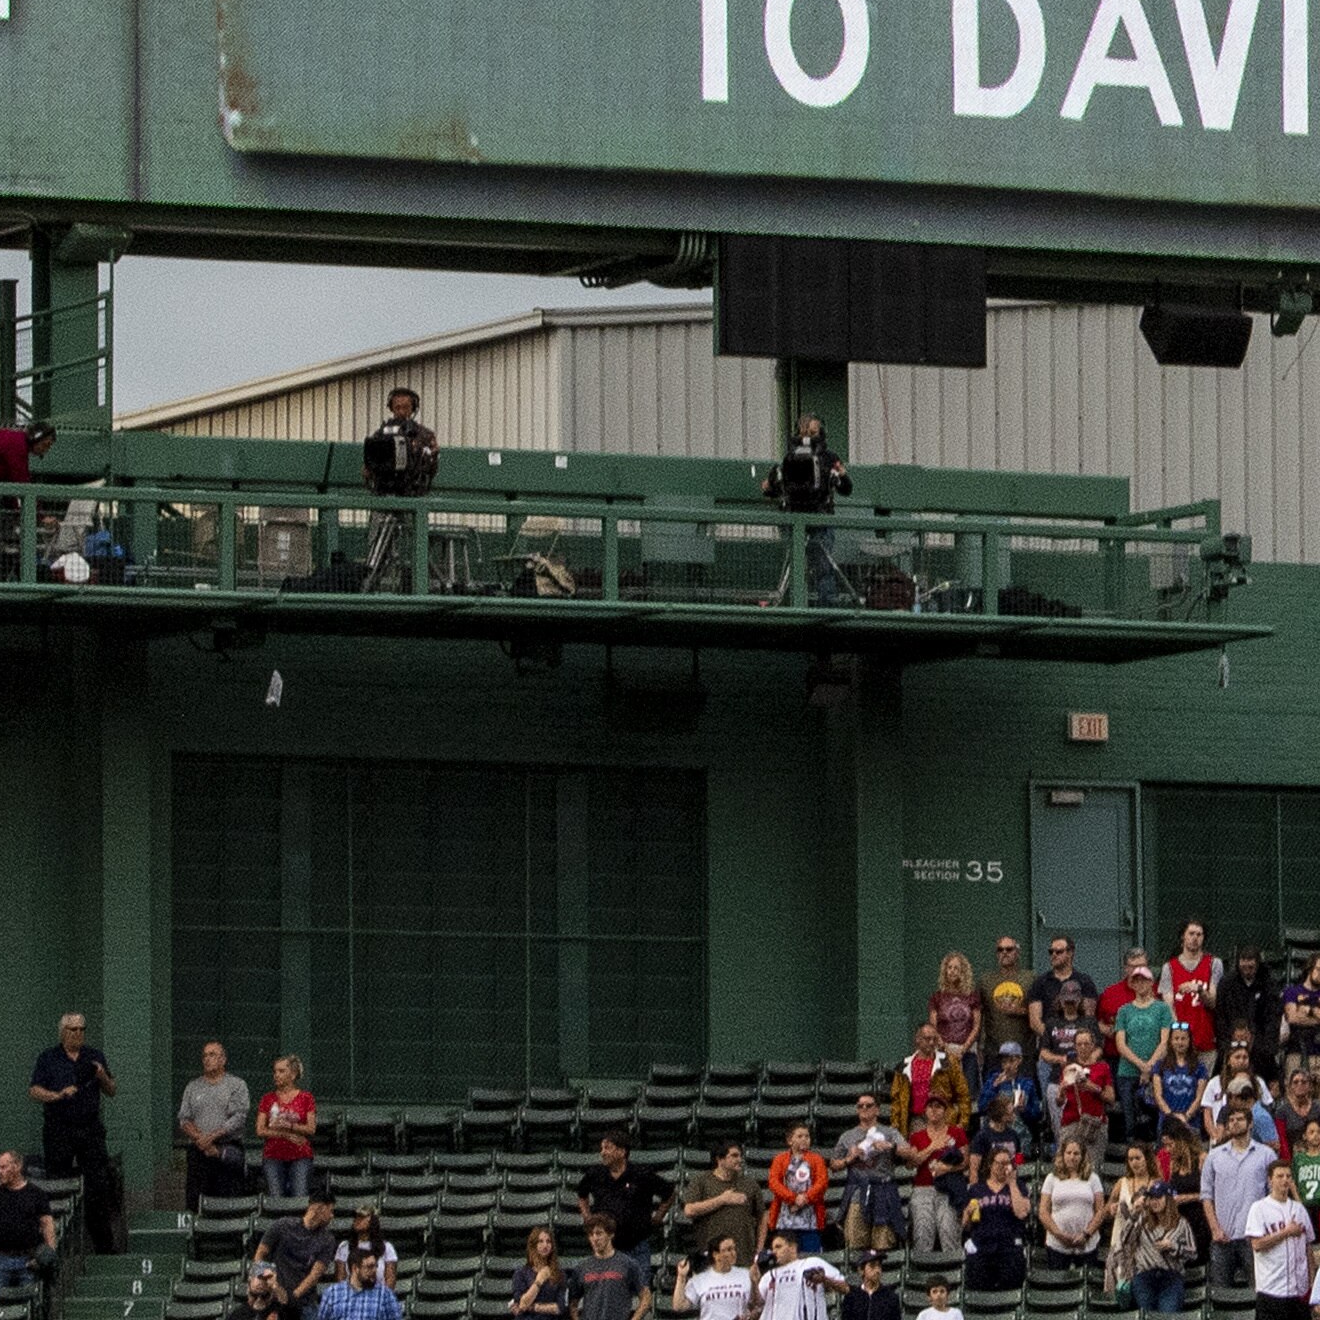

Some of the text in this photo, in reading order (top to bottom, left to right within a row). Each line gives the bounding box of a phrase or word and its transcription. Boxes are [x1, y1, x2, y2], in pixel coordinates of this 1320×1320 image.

[1078, 716, 1103, 737] EXIT
[965, 860, 1004, 883] 35
[1305, 1180, 1319, 1201] 7
[141, 1259, 153, 1275] 9
[131, 1279, 143, 1296] 8
[123, 1300, 135, 1317] 7
